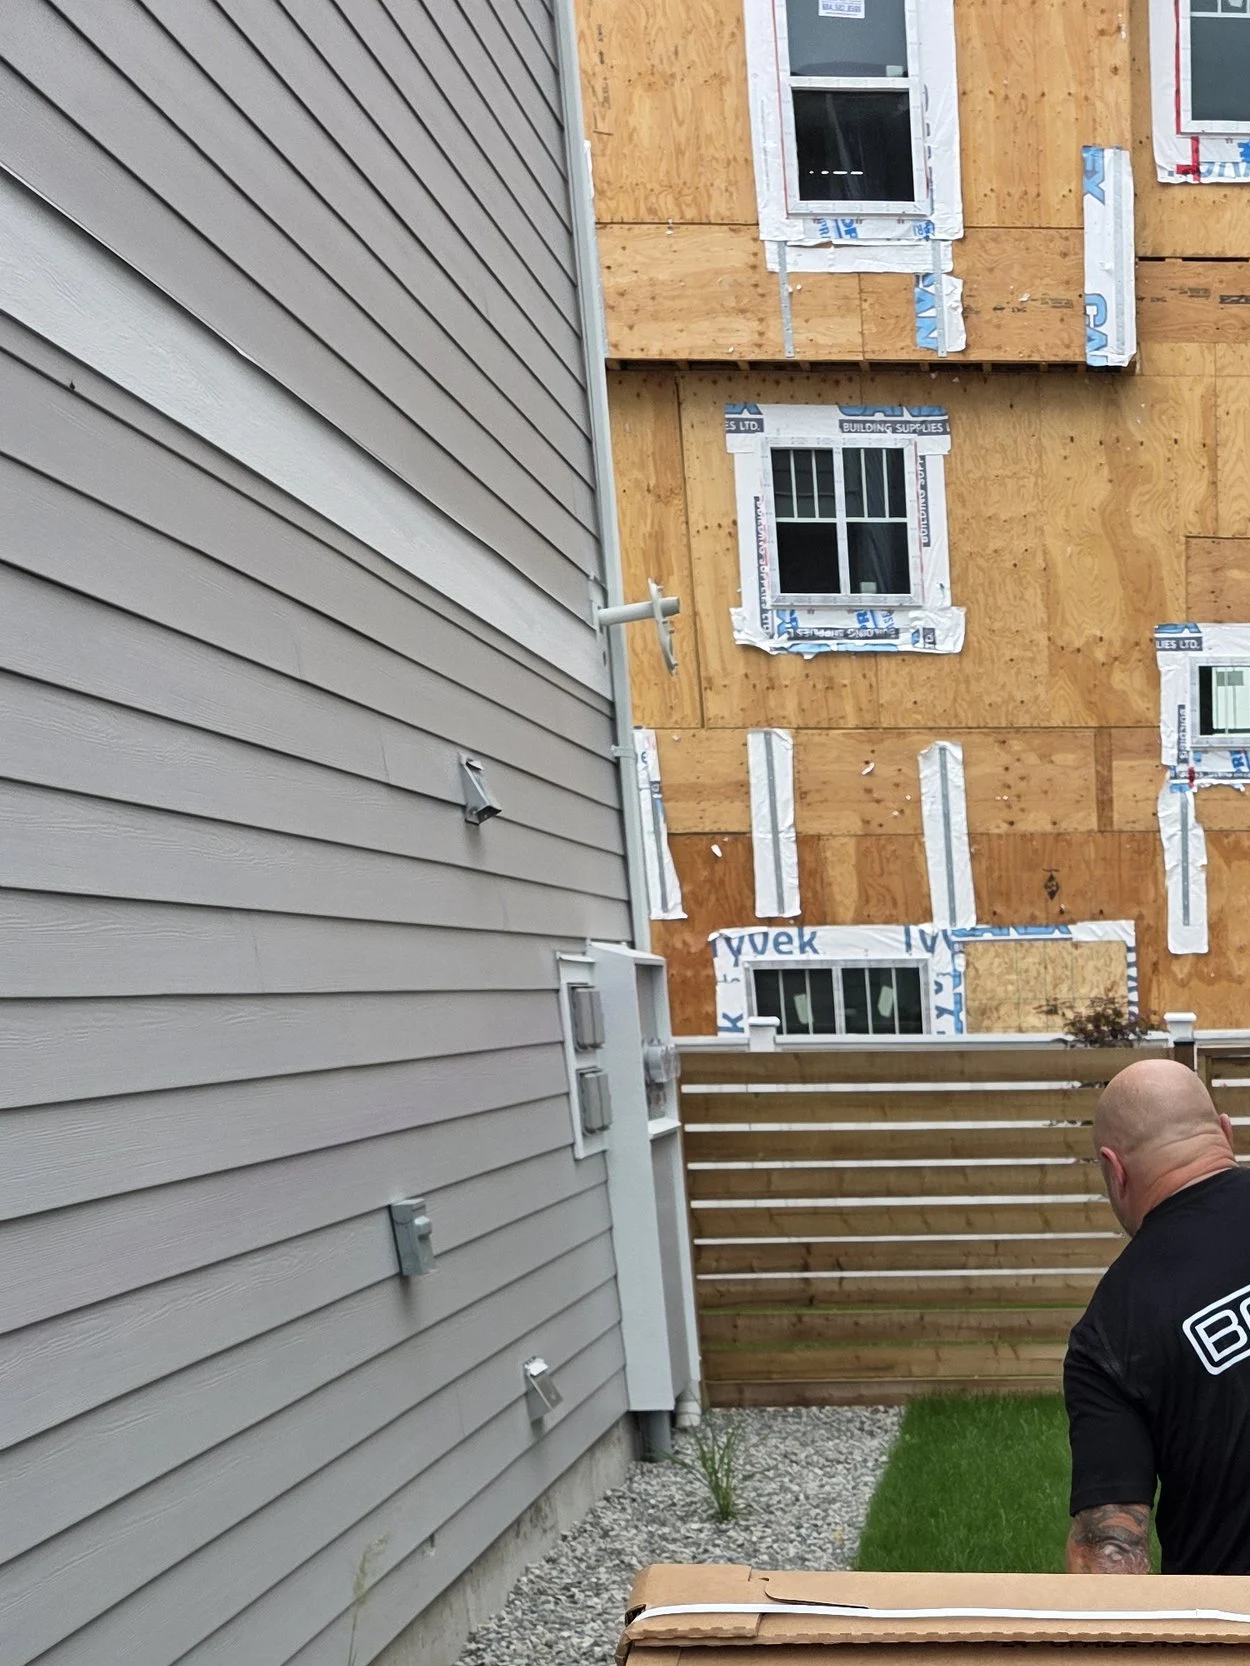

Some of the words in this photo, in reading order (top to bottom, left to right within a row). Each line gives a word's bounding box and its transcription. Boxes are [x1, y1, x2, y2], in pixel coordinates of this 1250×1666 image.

[739, 421, 761, 432] LTD.
[842, 422, 893, 433] BUILDING
[895, 422, 944, 433] SUPPLIES
[1179, 638, 1201, 650] LTD.
